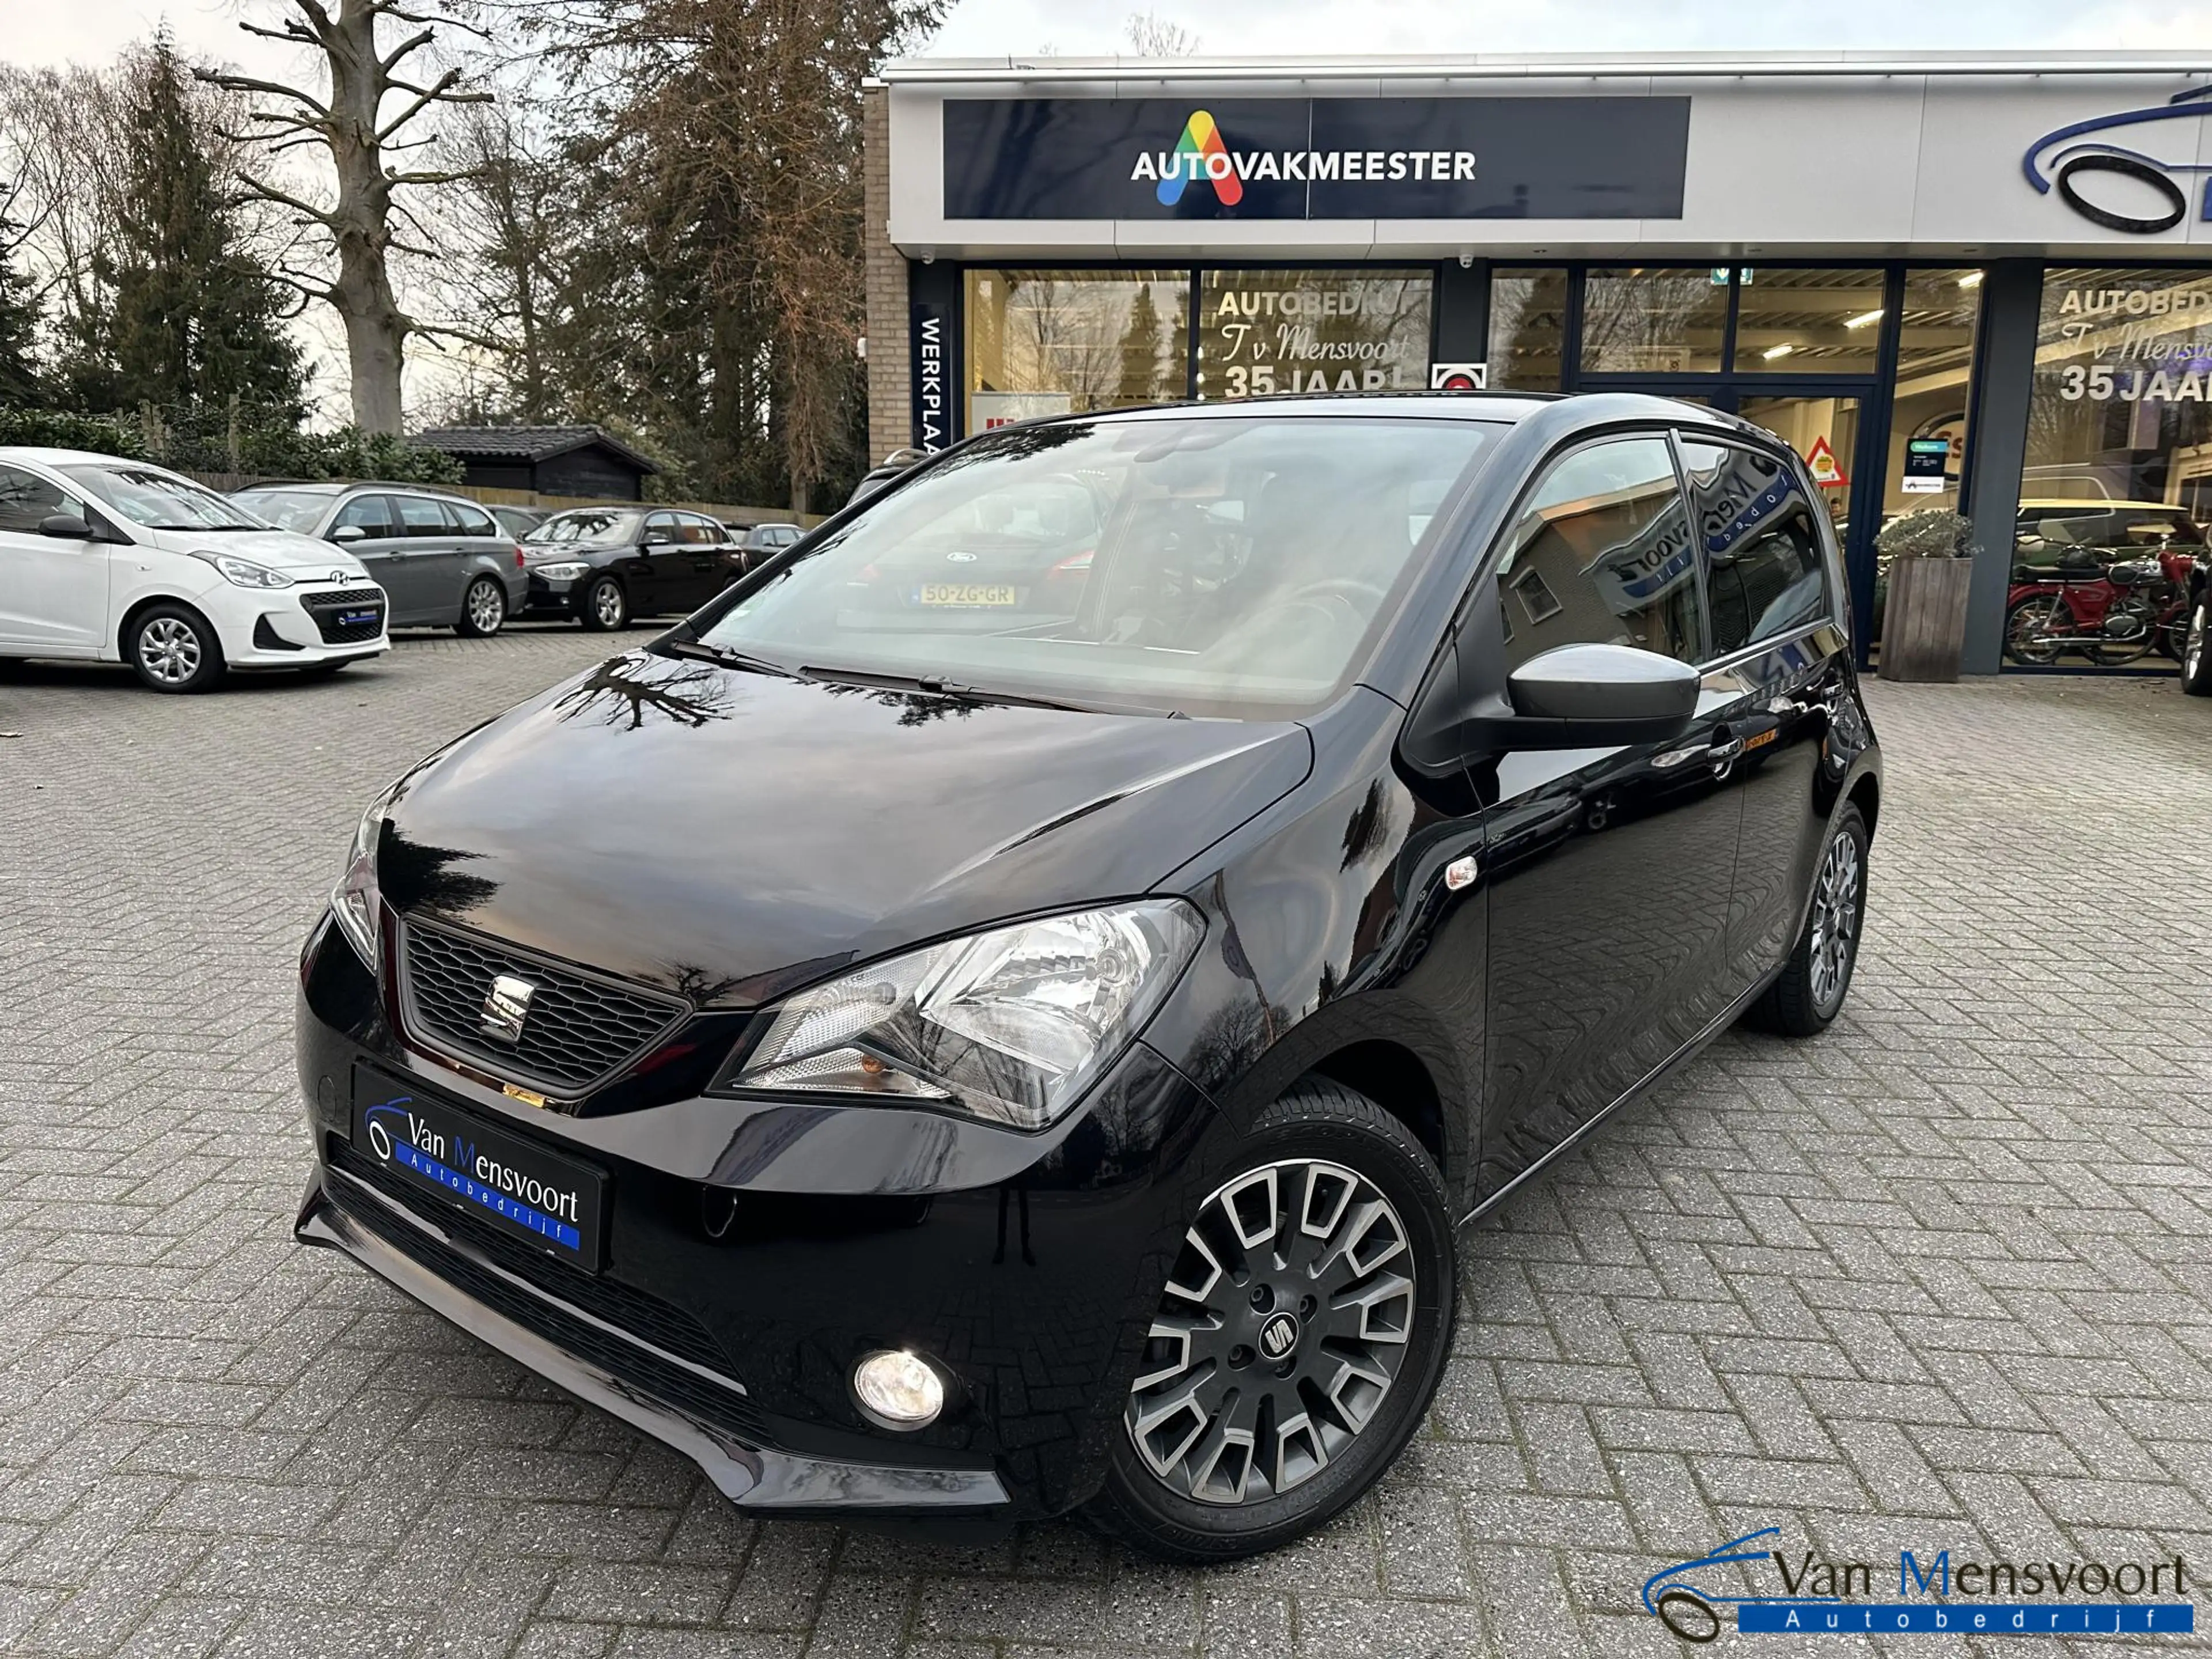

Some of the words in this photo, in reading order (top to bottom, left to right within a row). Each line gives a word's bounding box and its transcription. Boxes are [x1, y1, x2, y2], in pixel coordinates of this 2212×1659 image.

[1131, 151, 1476, 180] AUTOVAKMEESTER
[1221, 324, 1251, 362] T
[1253, 342, 1267, 361] v
[1276, 323, 1411, 361] Mensvoort
[1225, 365, 1275, 397] 35
[2059, 365, 2115, 401] 35
[2119, 370, 2212, 402] JAA
[926, 585, 1009, 602] 50-ZG-GR
[408, 1112, 445, 1158] Van
[454, 1135, 578, 1222] Mensvoort
[411, 1153, 562, 1238] Autobedrijf
